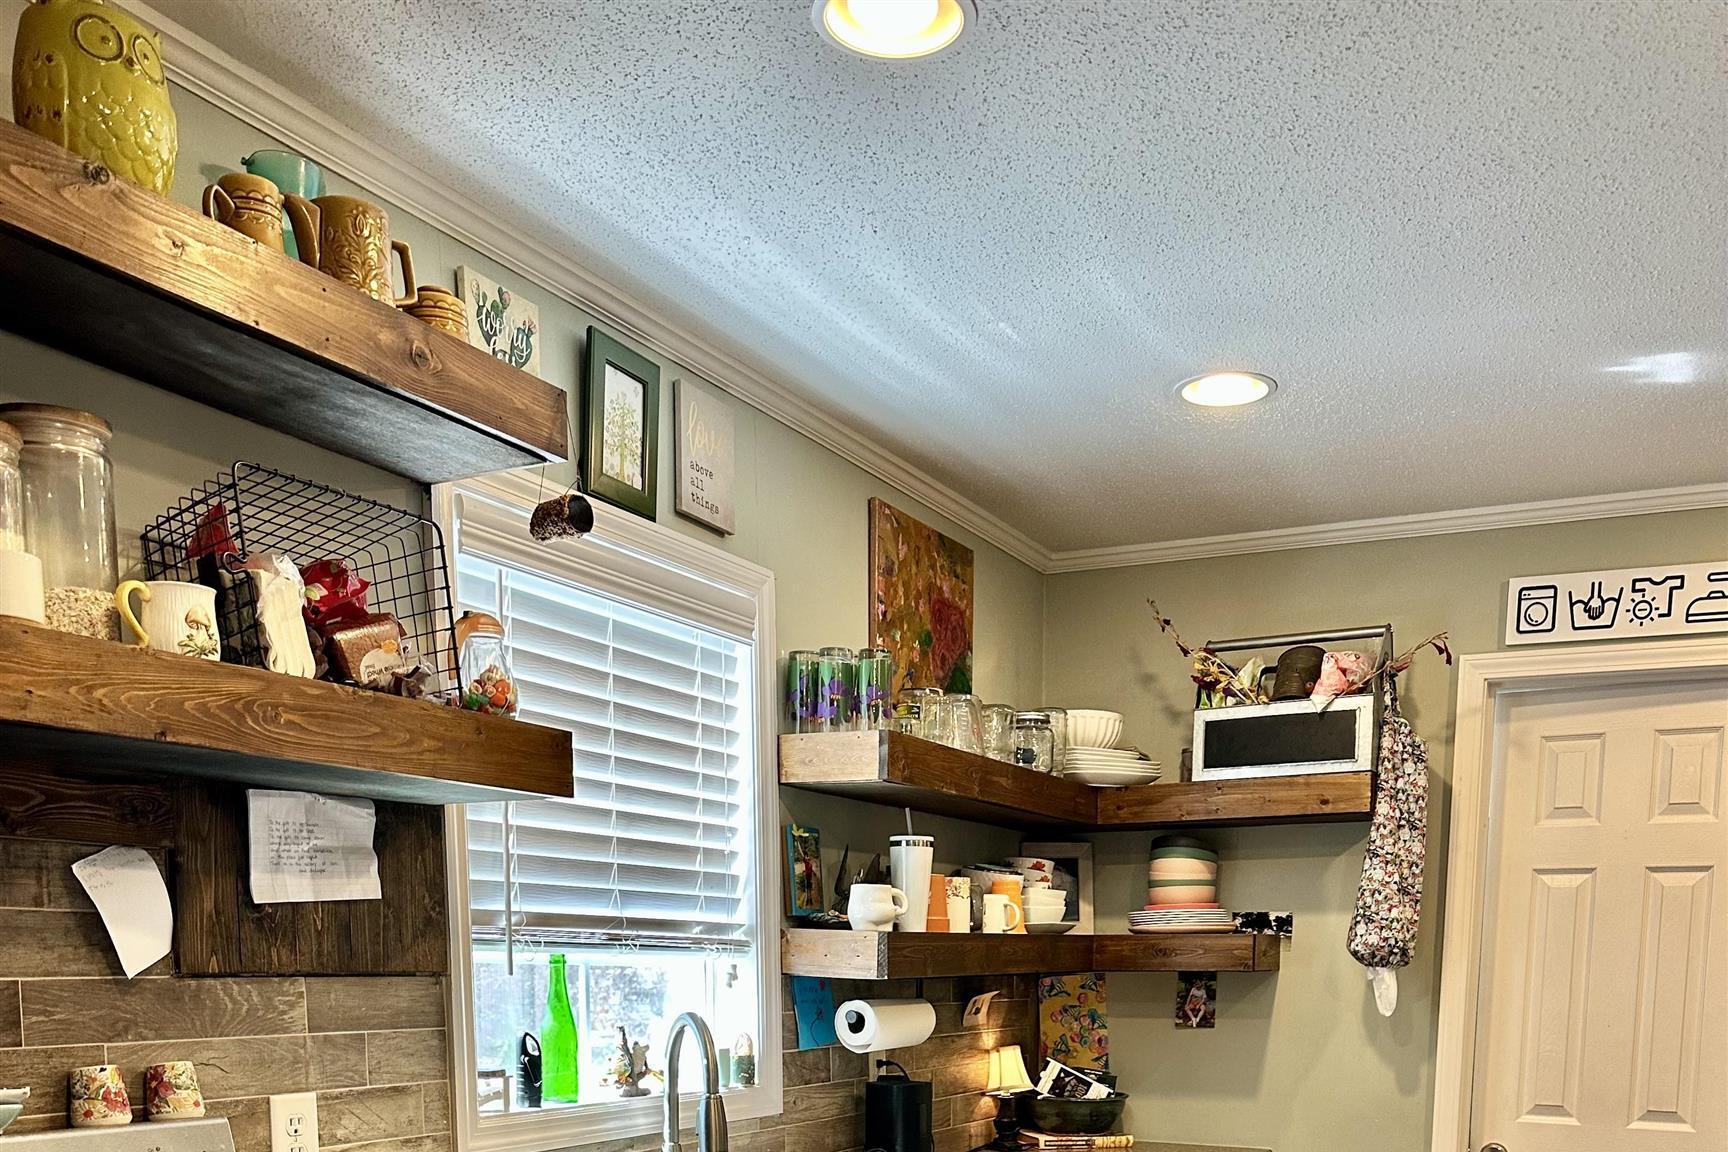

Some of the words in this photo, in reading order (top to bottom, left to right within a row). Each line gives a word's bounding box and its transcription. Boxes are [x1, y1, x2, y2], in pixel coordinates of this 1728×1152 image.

[477, 307, 531, 362] worry
[690, 460, 714, 480] above
[690, 476, 705, 492] all
[690, 492, 720, 515] things
